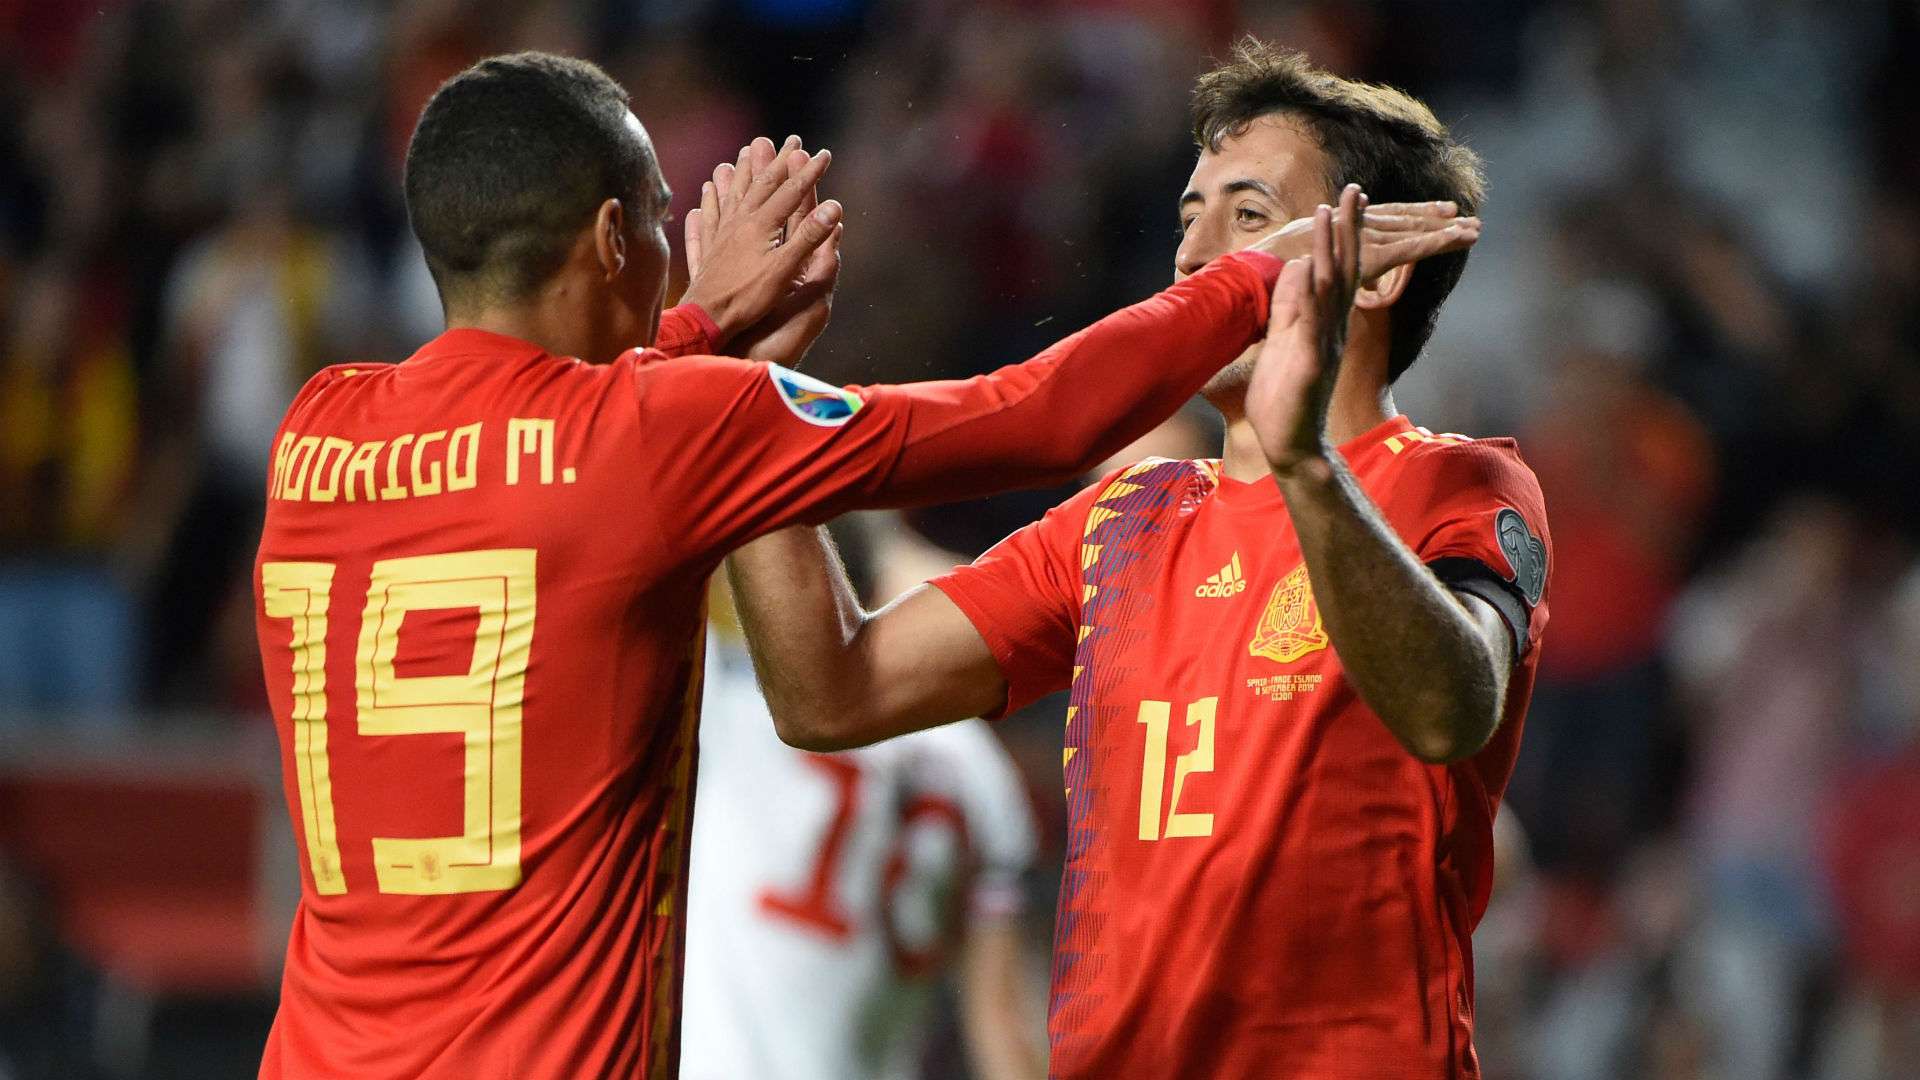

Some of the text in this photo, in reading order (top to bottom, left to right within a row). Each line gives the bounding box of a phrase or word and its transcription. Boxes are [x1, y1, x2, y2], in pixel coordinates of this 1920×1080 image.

[270, 417, 577, 502] RODRIGO M.
[1195, 579, 1246, 598] adids
[262, 548, 537, 896] 19
[1136, 696, 1219, 841] 12
